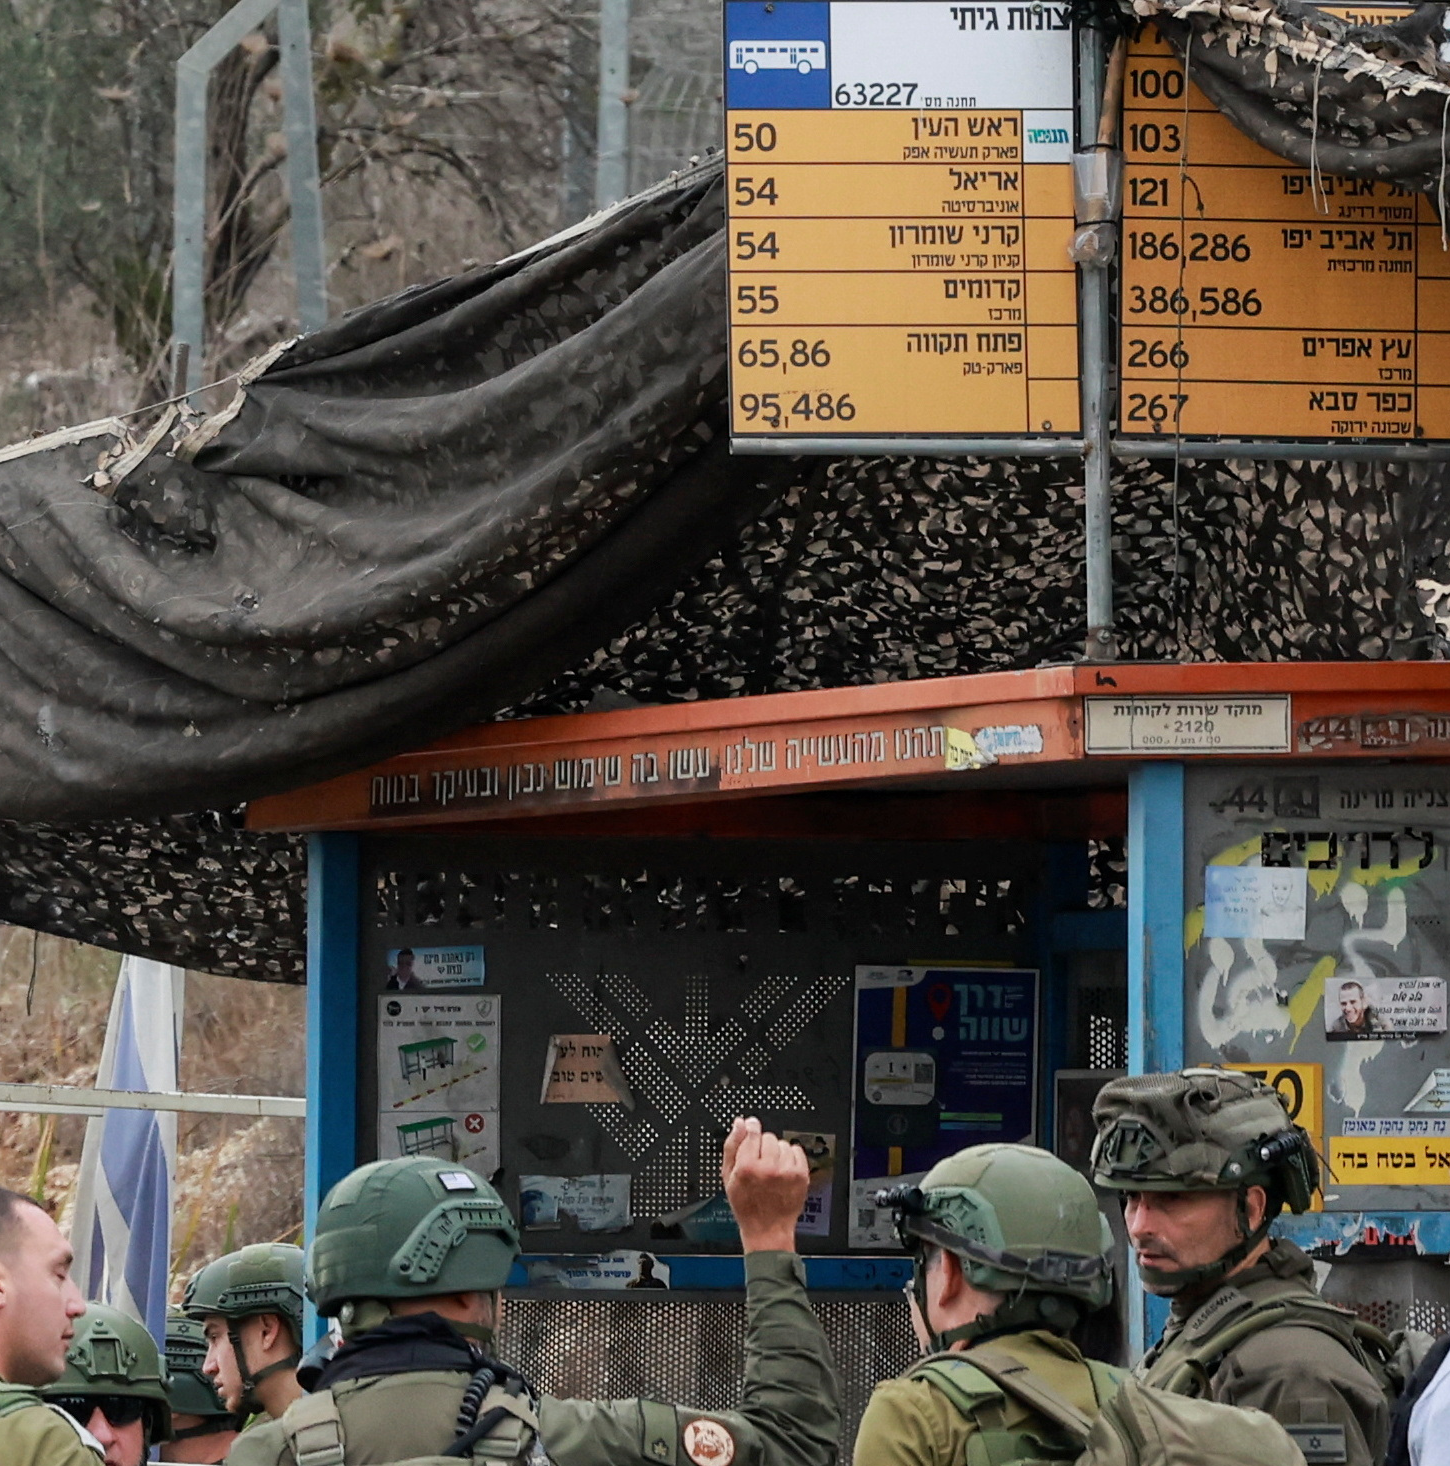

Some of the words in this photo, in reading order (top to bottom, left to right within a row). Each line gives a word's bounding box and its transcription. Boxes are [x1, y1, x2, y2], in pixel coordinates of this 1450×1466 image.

[951, 7, 999, 31] גיתי
[835, 83, 918, 106] 63227
[1130, 70, 1184, 99] 100
[947, 96, 976, 108] תחנה
[734, 123, 777, 152] 50
[911, 117, 959, 141] העין
[967, 116, 1019, 138] ראש
[1129, 124, 1181, 153] 103
[903, 147, 929, 160] אפק
[934, 147, 978, 159] תעשיה
[982, 147, 1019, 161] פארק
[949, 168, 1019, 191] אריאל
[1282, 175, 1312, 196] יפו
[735, 178, 779, 206] 54
[1129, 178, 1168, 207] 121
[942, 200, 1019, 213] אוניברסיטה
[1379, 206, 1413, 219] מסוף
[736, 231, 780, 260] 54
[889, 225, 964, 248] שומרון
[973, 225, 1020, 246] קרני
[1282, 229, 1312, 249] יפו
[1320, 229, 1374, 250] אביב
[1383, 228, 1412, 250] תל
[1129, 231, 1251, 268] 186,286
[911, 254, 956, 269] שומרון
[961, 254, 988, 268] קרני
[992, 254, 1021, 269] קניון
[1327, 259, 1374, 272] מרכזית
[1380, 260, 1412, 273] תחנה
[737, 286, 780, 314] 55
[943, 279, 1021, 300] קדומים
[988, 308, 1022, 321] מרכז
[1128, 286, 1263, 322] 386,586
[907, 333, 968, 355] תקווה
[977, 333, 1022, 353] פתח
[1127, 340, 1189, 368] 266
[1302, 338, 1372, 358] אפרים
[1381, 338, 1411, 360] עץ
[738, 340, 831, 375] 65,86
[963, 362, 1023, 376] פארק-טק
[1378, 368, 1411, 380] מרכז
[739, 393, 856, 428] 95,486
[1127, 394, 1189, 422] 267
[1309, 392, 1358, 412] סבא
[1375, 392, 1412, 412] כפר
[1331, 421, 1367, 434] ירוקה
[1371, 421, 1411, 434] שכונה
[1113, 703, 1171, 717] לקוחות
[1177, 704, 1218, 716] שרות
[1224, 704, 1262, 716] מוקד
[725, 736, 776, 775] שלנו
[786, 731, 885, 769] מהעשייה
[554, 755, 621, 790] שימוש
[632, 752, 658, 783] בה
[669, 748, 710, 779] עשו
[372, 775, 419, 805] בטוח
[431, 766, 499, 805] ובעיקר
[508, 763, 544, 800] נכון
[959, 1017, 1027, 1042] שווה
[1377, 1152, 1416, 1168] בטח
